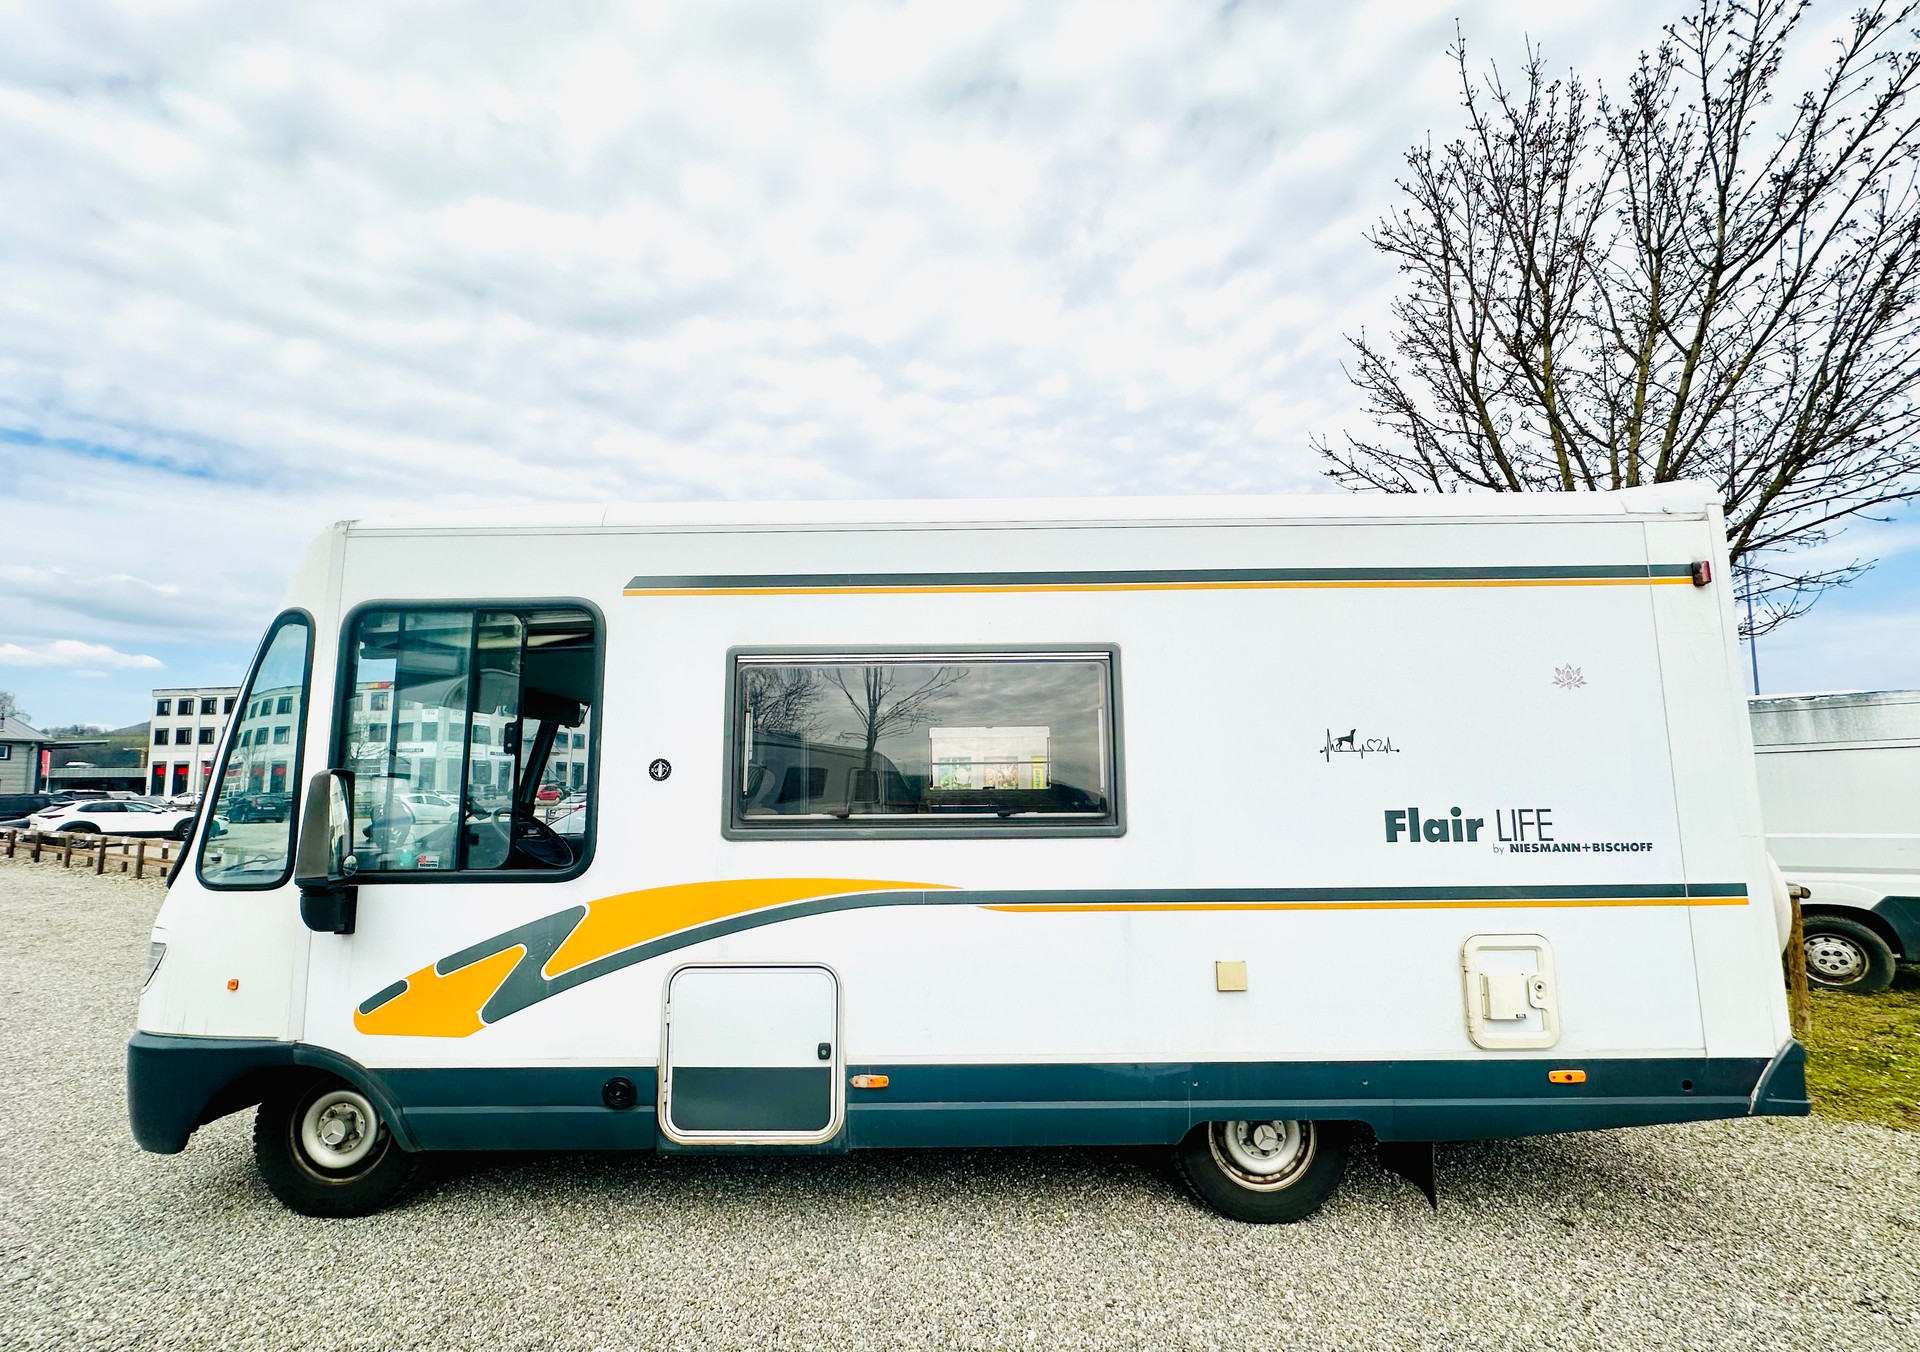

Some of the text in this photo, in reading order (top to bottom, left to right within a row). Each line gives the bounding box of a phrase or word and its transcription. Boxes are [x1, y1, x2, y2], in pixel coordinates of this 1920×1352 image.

[1384, 806, 1554, 843] Flair LIFE
[1492, 842, 1653, 855] by NIESMANN+BISCHOFF
